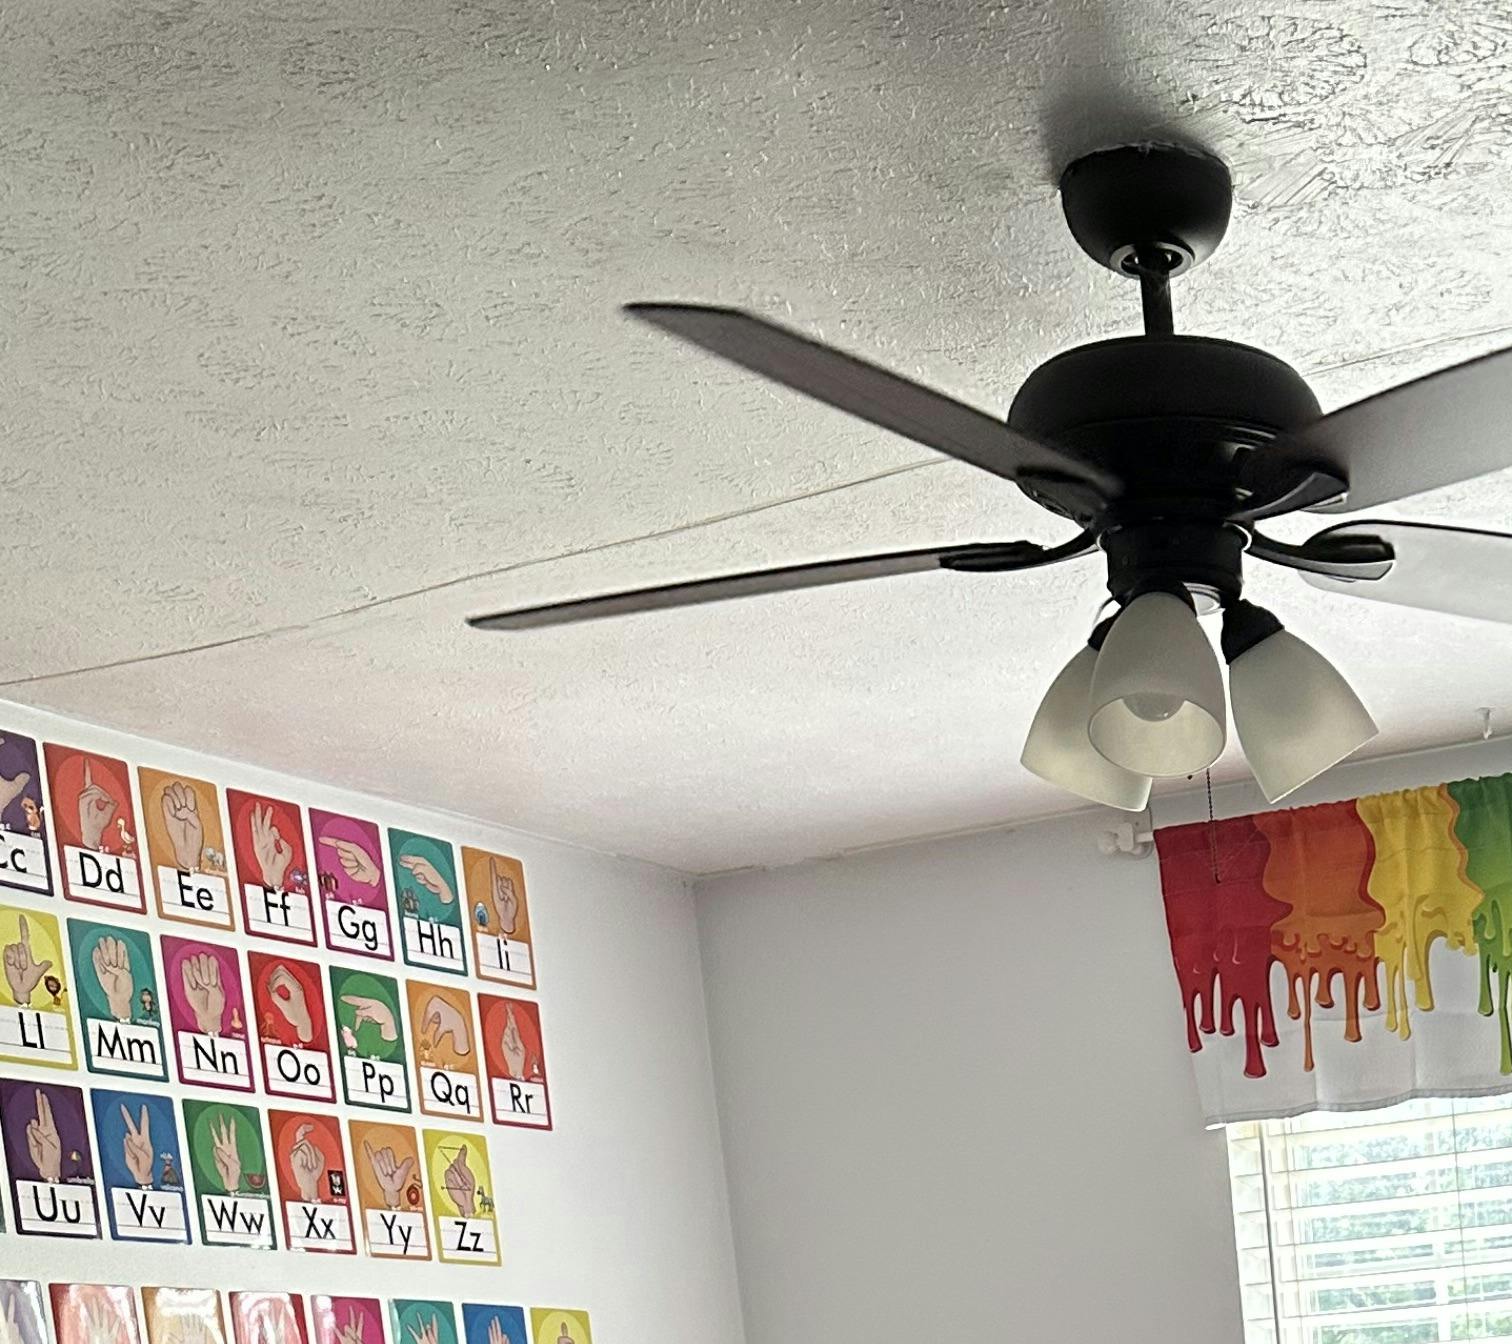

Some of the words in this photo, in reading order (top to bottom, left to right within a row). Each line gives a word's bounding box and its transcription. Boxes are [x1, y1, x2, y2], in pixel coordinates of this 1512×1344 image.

[78, 851, 124, 894] Dd
[177, 869, 214, 911] Ee
[263, 887, 291, 926] Ff
[338, 905, 378, 950] Gg
[417, 920, 454, 959] Hh
[496, 938, 510, 971] Ii
[18, 1011, 45, 1049] Ll
[97, 1023, 156, 1064] Mm
[192, 1036, 239, 1075] Nn
[277, 1049, 321, 1085] Oo
[362, 1061, 395, 1103] Pp
[431, 1071, 471, 1114] Qq
[509, 1083, 534, 1114] Rr
[32, 1185, 81, 1224] Uu
[125, 1192, 166, 1228] Vv
[206, 1198, 264, 1235] Ww
[302, 1206, 336, 1240] Xx
[380, 1213, 412, 1255] Yy
[454, 1221, 484, 1252] Zz
